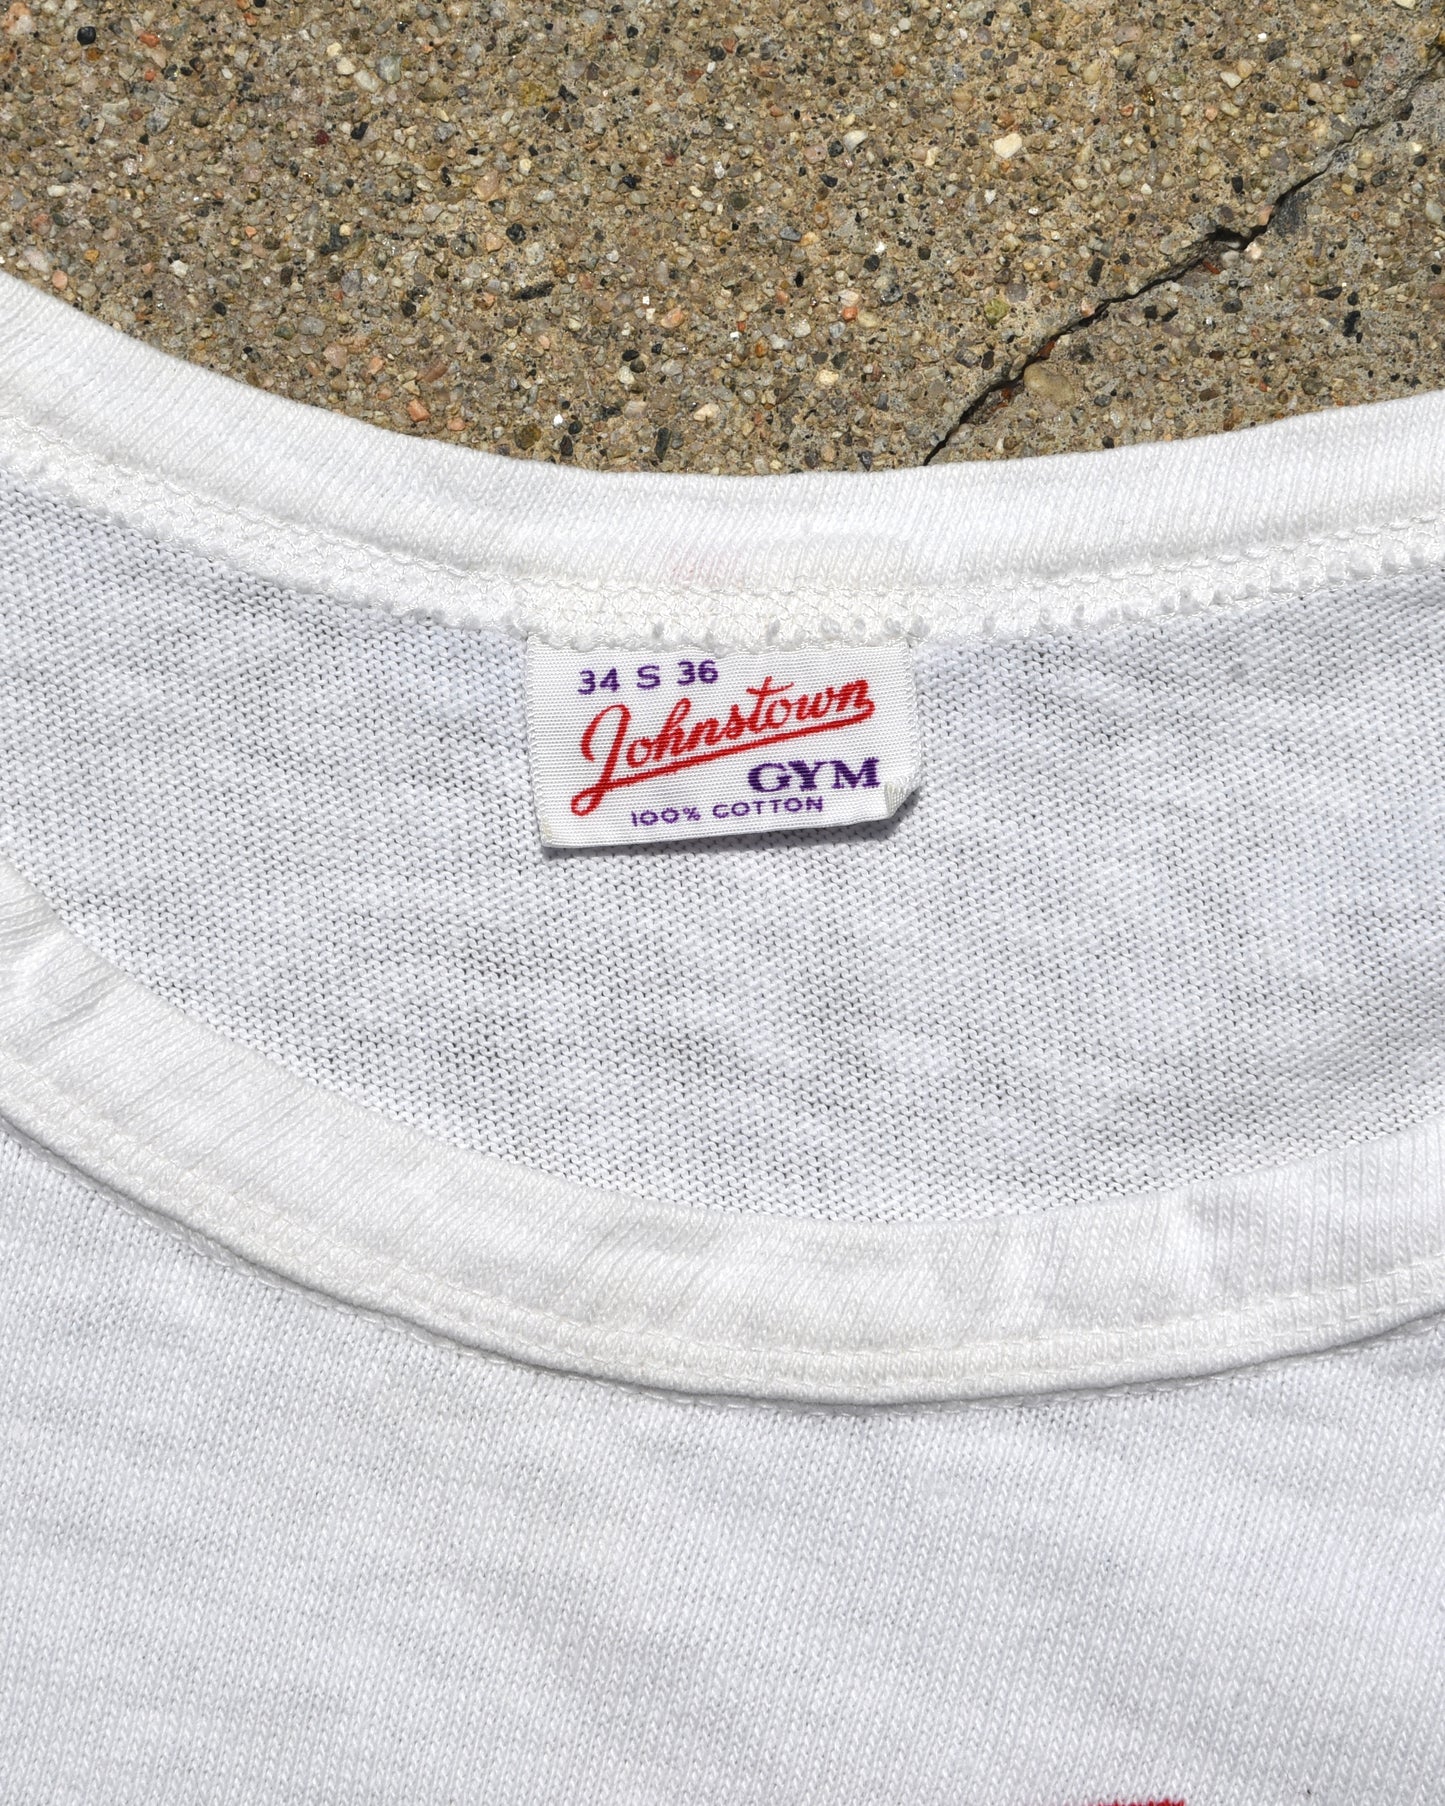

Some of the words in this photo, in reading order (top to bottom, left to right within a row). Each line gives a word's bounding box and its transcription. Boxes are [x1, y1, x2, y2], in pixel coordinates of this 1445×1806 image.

[578, 667, 620, 695] 34
[636, 665, 661, 690] S
[677, 659, 719, 686] 36
[570, 676, 876, 816] Johnstown
[747, 757, 881, 794] GYM
[631, 806, 702, 827] 100%
[712, 796, 824, 819] COTTON
